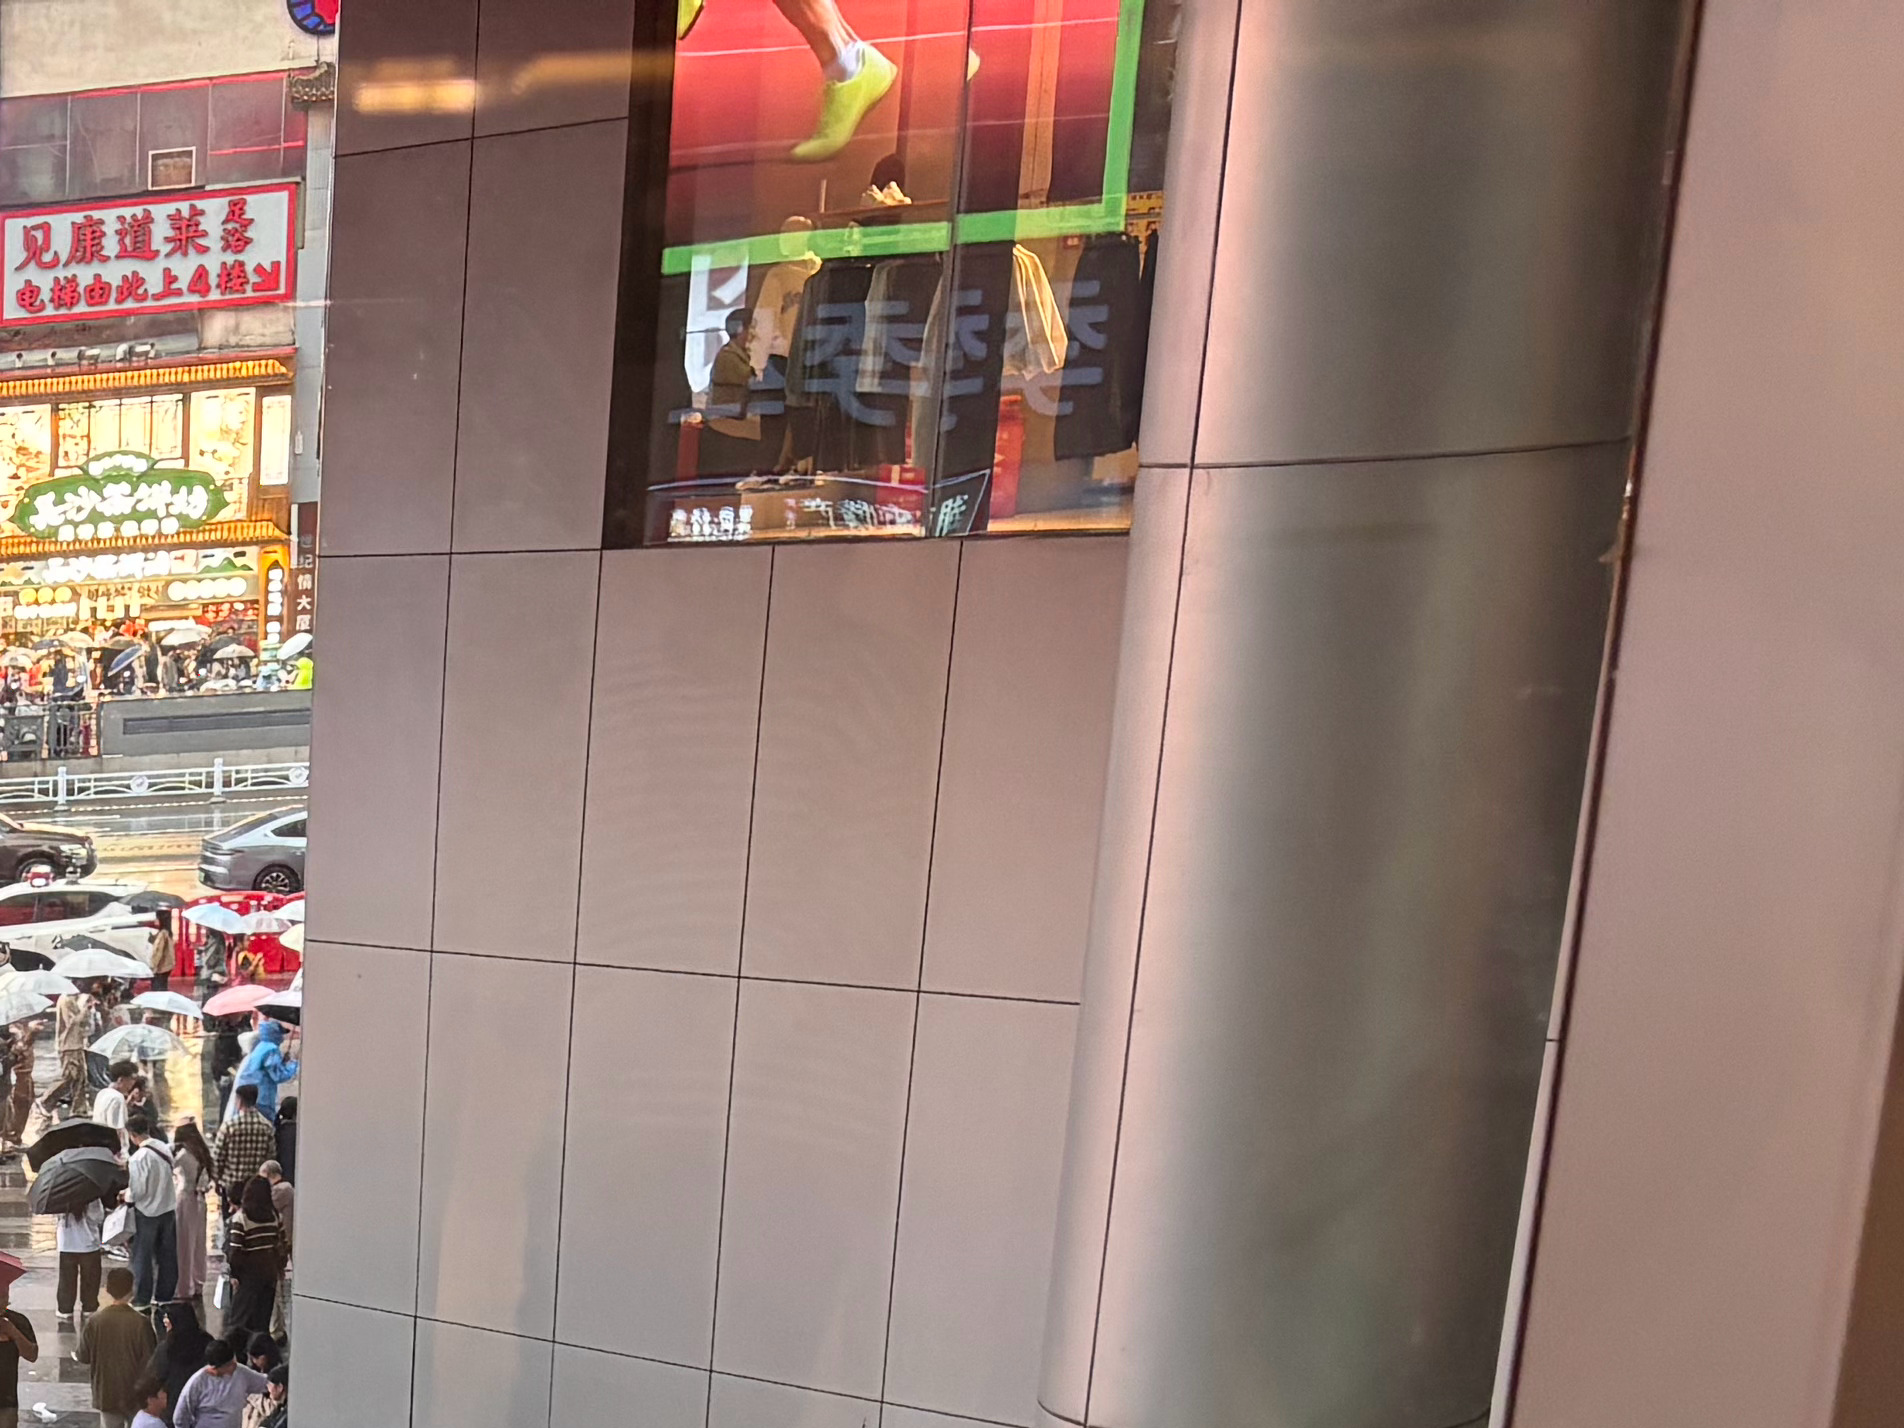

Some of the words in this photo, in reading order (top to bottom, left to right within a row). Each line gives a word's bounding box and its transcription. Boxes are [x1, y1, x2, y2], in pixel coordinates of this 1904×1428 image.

[15, 204, 211, 272] 见康道莱
[16, 259, 250, 313] 电梯由此上4楼
